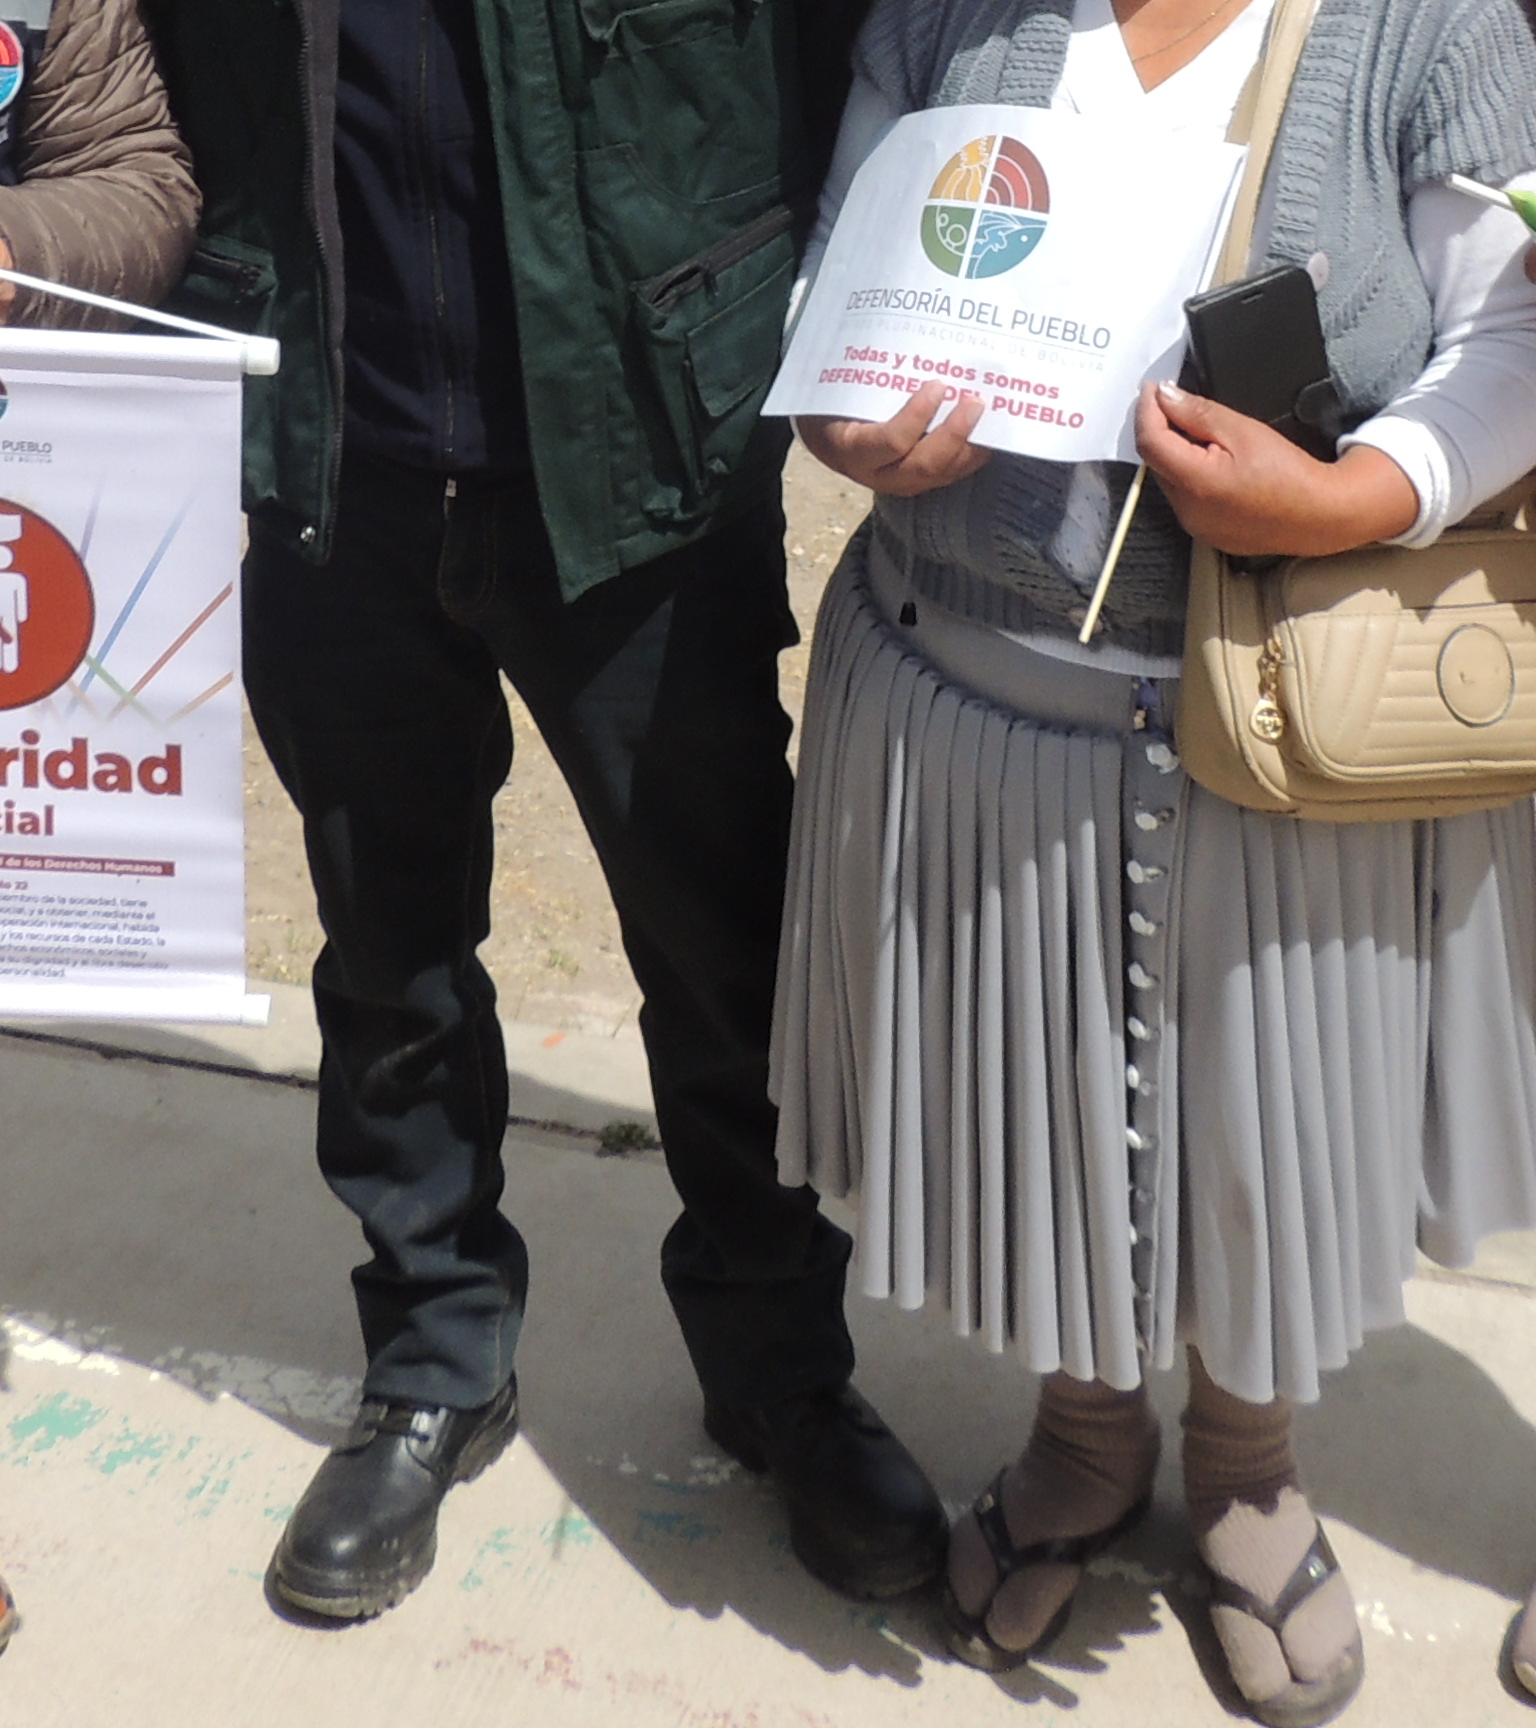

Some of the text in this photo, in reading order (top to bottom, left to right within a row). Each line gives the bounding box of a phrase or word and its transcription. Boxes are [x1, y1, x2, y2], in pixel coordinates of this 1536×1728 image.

[846, 288, 1111, 350] DEFENSORÍA DEL PUEBLO
[818, 368, 924, 394] DEFENSORE
[991, 396, 1085, 429] PUEBLO
[843, 345, 1060, 400] Todas y todos somos
[2, 440, 53, 454] PUEBLO
[6, 856, 22, 868] de
[23, 856, 42, 869] los
[44, 858, 102, 872] Derechos
[104, 861, 163, 874] Humanos
